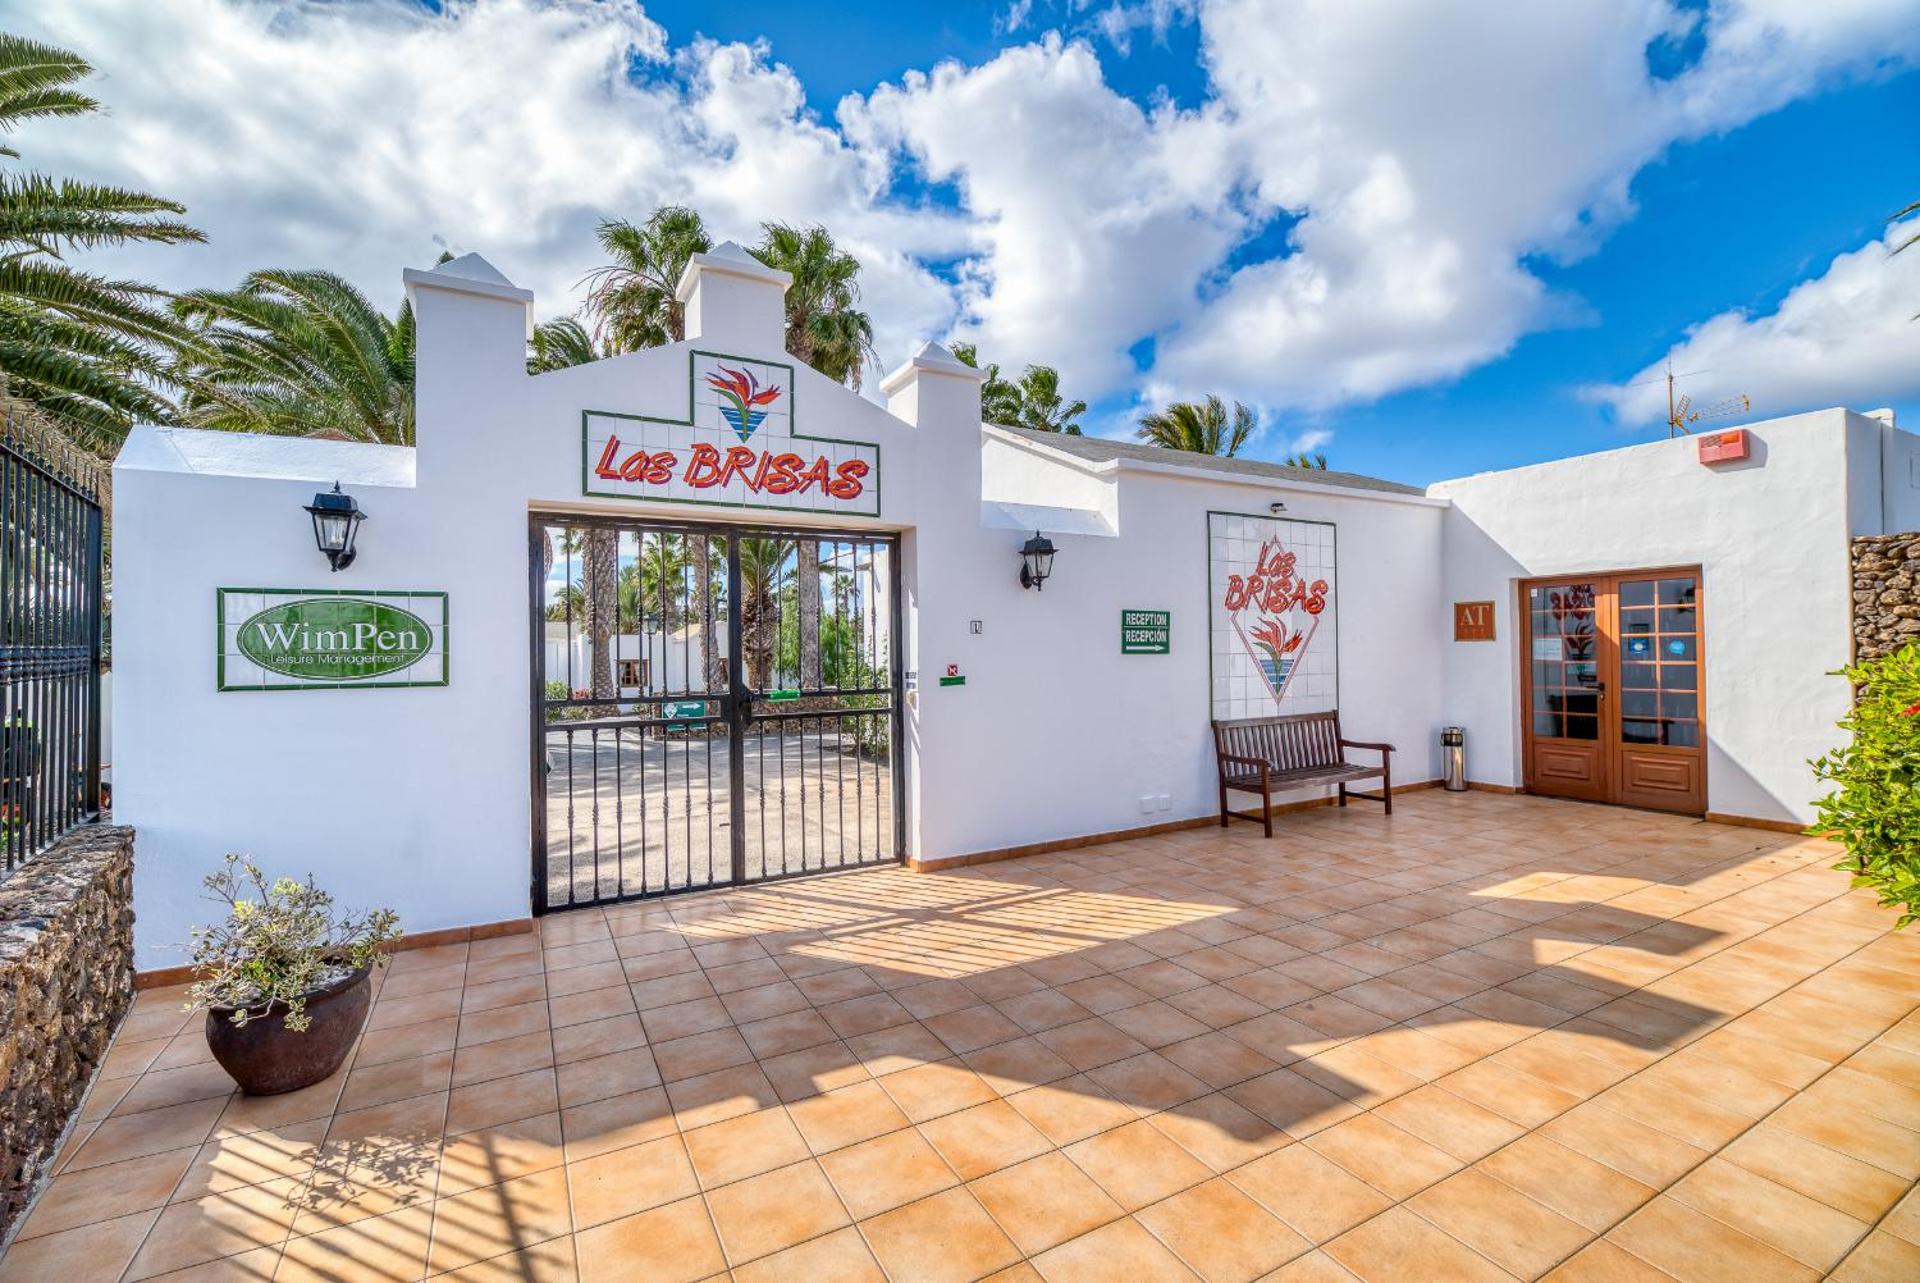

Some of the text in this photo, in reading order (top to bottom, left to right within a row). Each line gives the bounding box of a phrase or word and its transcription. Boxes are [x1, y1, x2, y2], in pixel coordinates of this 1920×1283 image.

[595, 433, 870, 500] Las BRISAS
[1225, 575, 1329, 615] BRISAS
[1125, 612, 1167, 626] RECEPTION
[1459, 605, 1489, 626] AT
[256, 622, 420, 651] WimPen
[271, 654, 407, 666] Leisure Management
